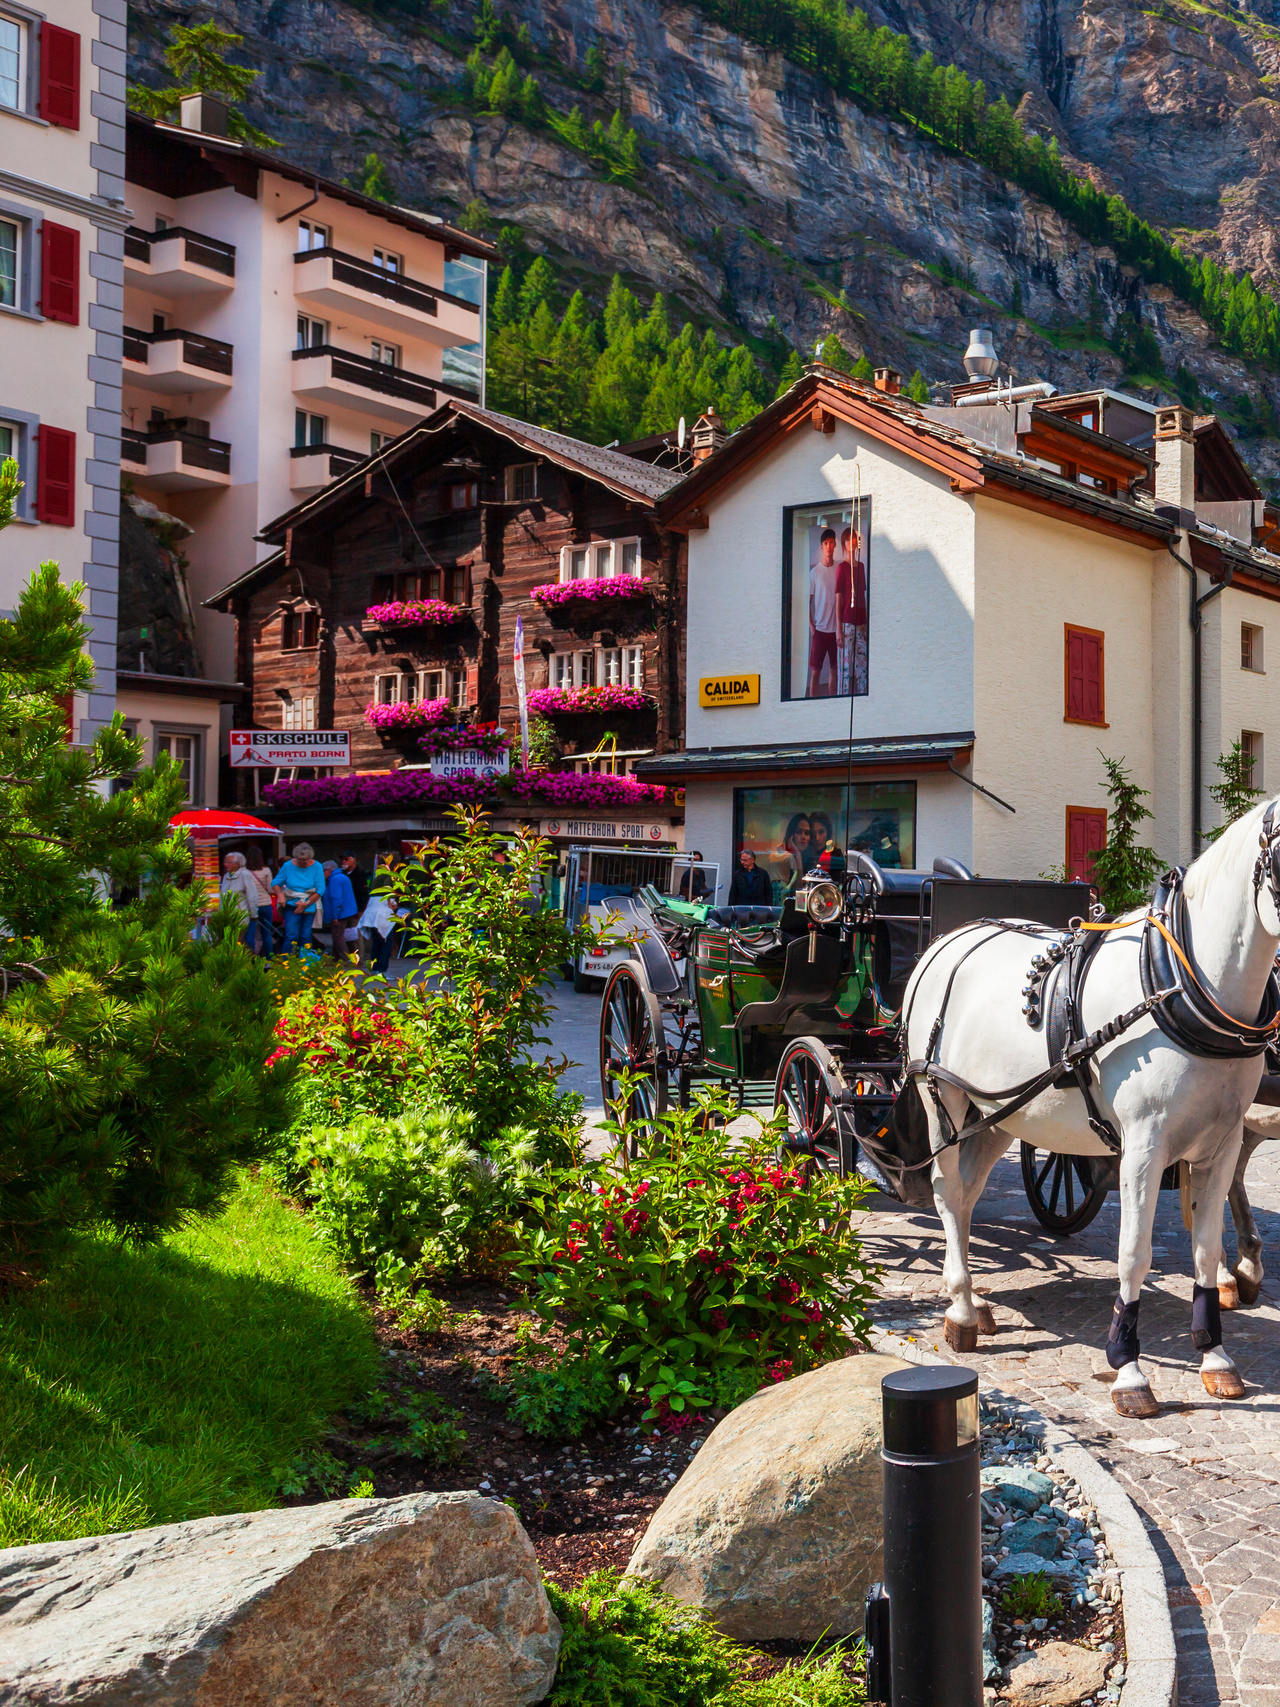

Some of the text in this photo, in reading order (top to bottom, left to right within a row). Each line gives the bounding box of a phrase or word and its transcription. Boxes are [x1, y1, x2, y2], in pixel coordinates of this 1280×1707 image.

[704, 680, 750, 696] CALIDA
[256, 734, 345, 744] SKISCHULE
[567, 821, 645, 839] MATTERHORN SPORT
